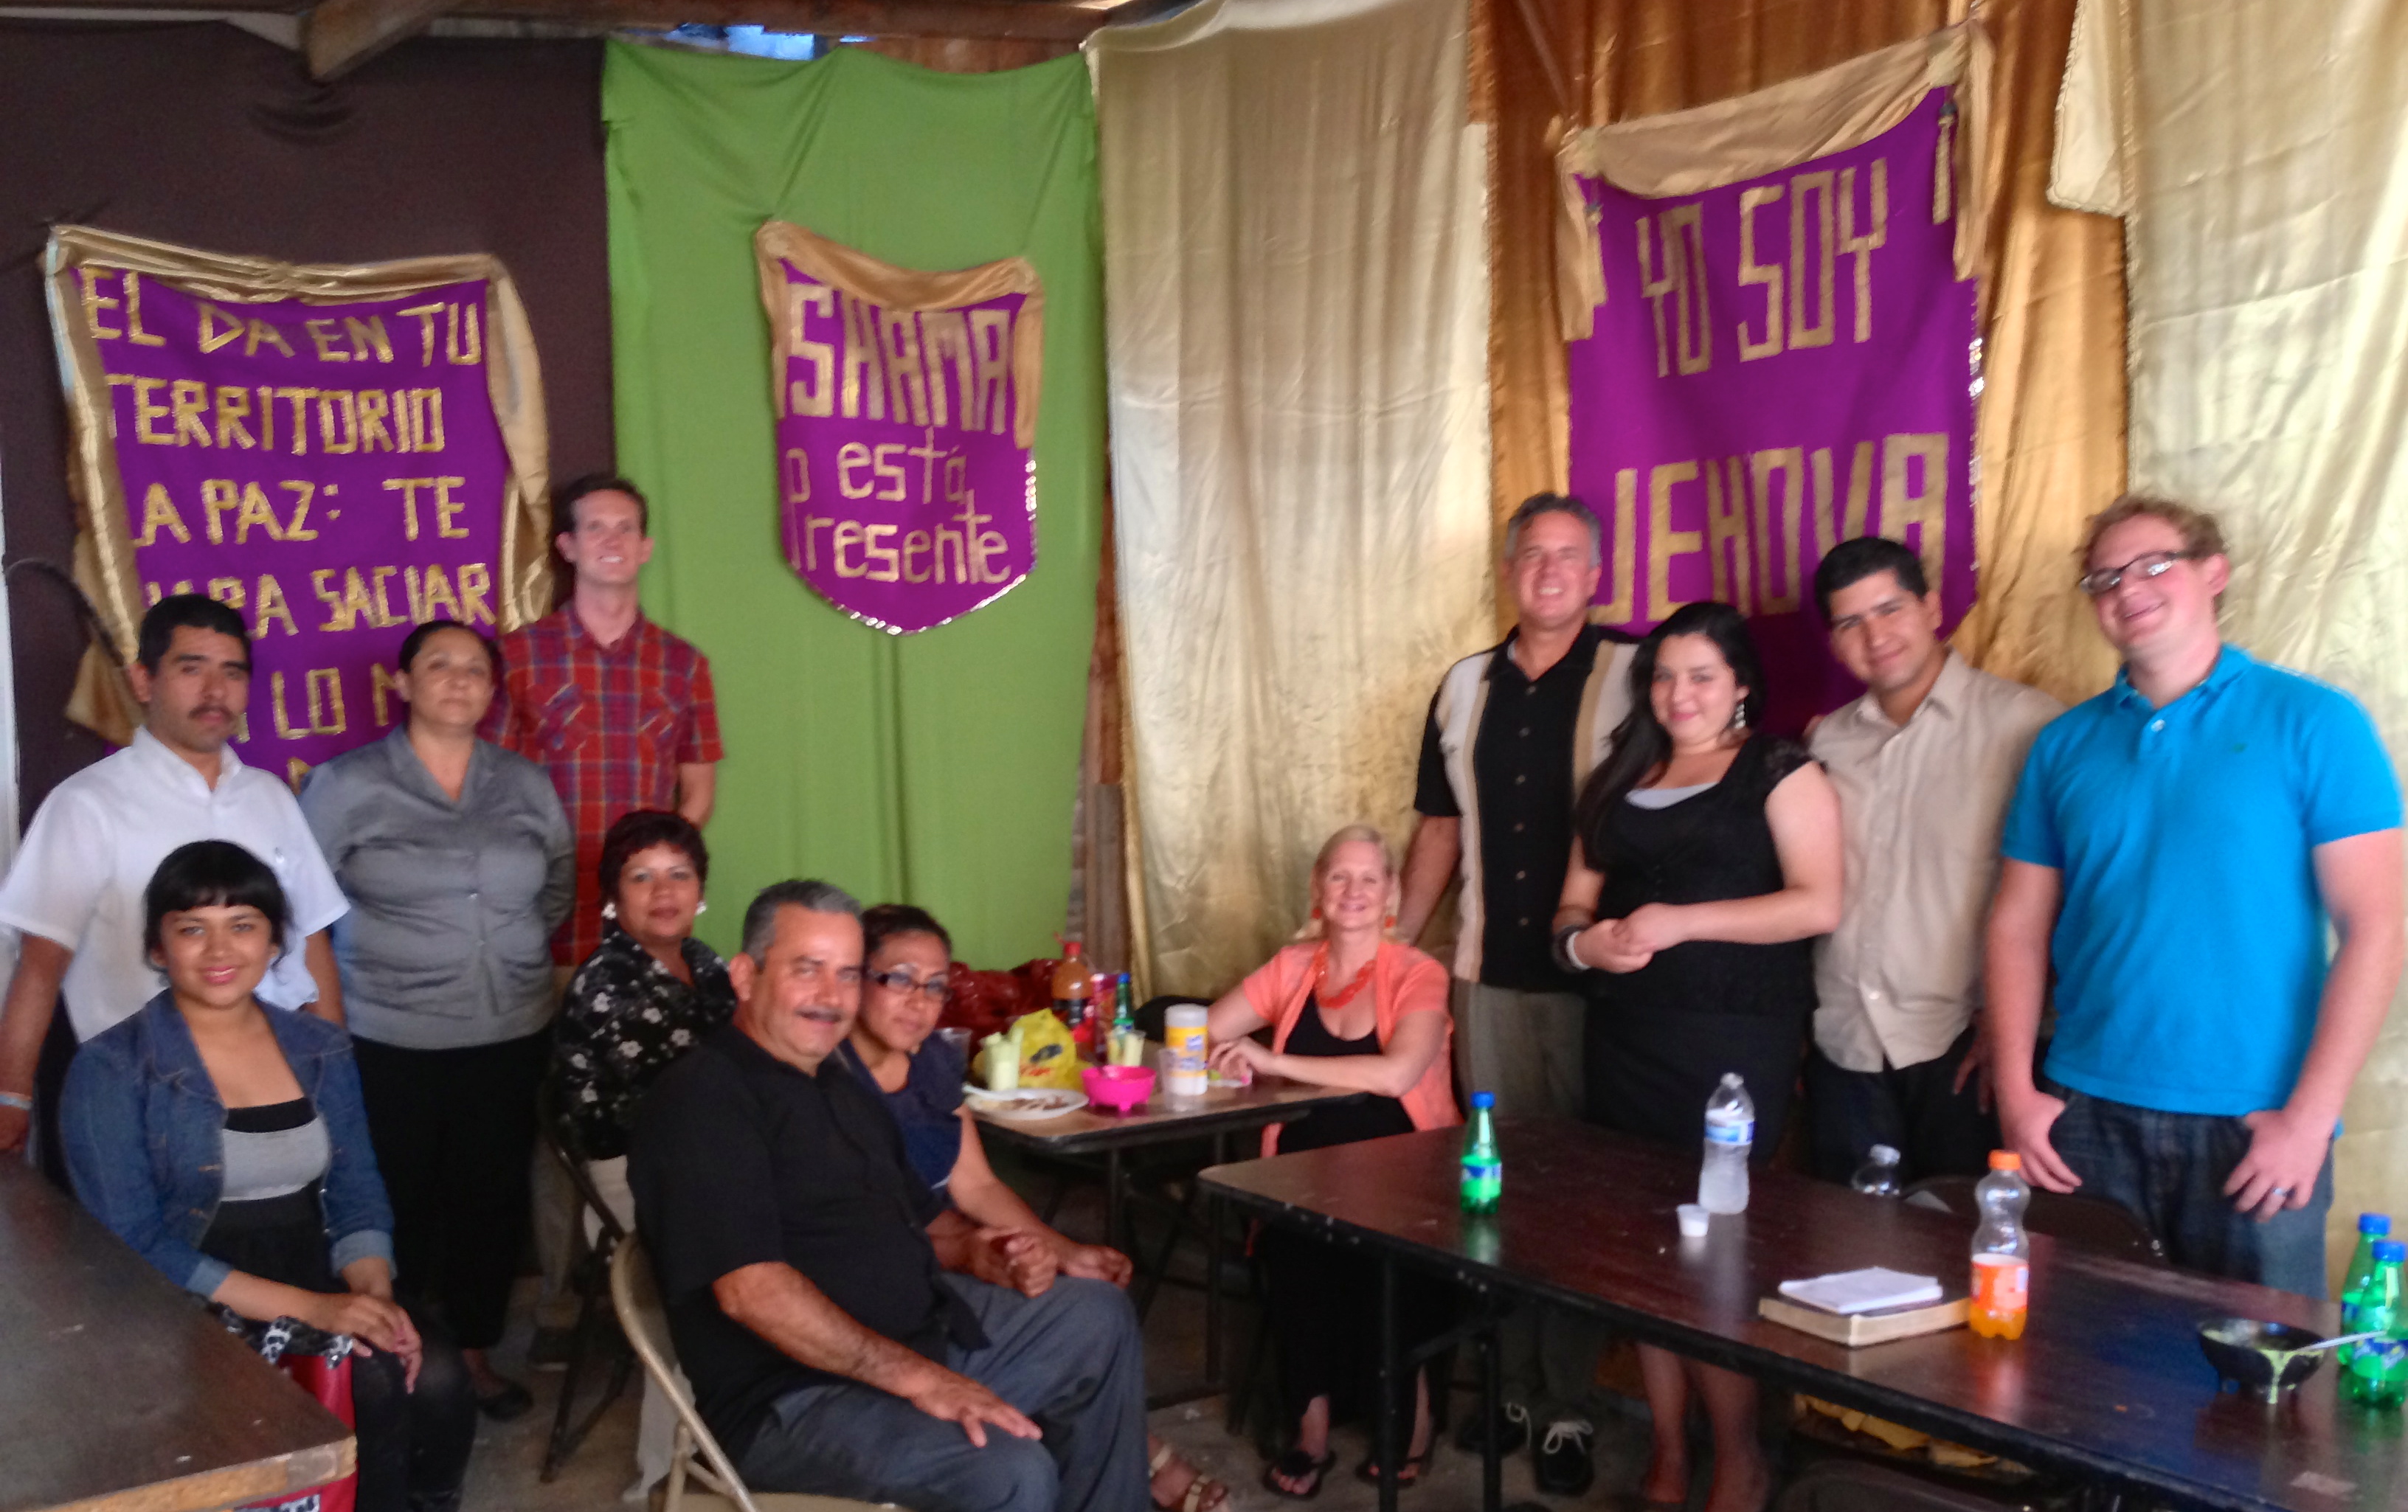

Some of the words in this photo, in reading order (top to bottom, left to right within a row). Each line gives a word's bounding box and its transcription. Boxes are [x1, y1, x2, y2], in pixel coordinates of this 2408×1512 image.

[1634, 201, 1712, 378] YO
[1737, 157, 1889, 363] SOY
[79, 267, 167, 347] EL
[197, 302, 296, 358] DA
[305, 314, 394, 364] EN
[395, 301, 482, 368] TU
[381, 475, 470, 542] TE
[1588, 431, 1950, 625] JEHOVA
[311, 562, 497, 633] SACIAR
[271, 667, 347, 740] LO
